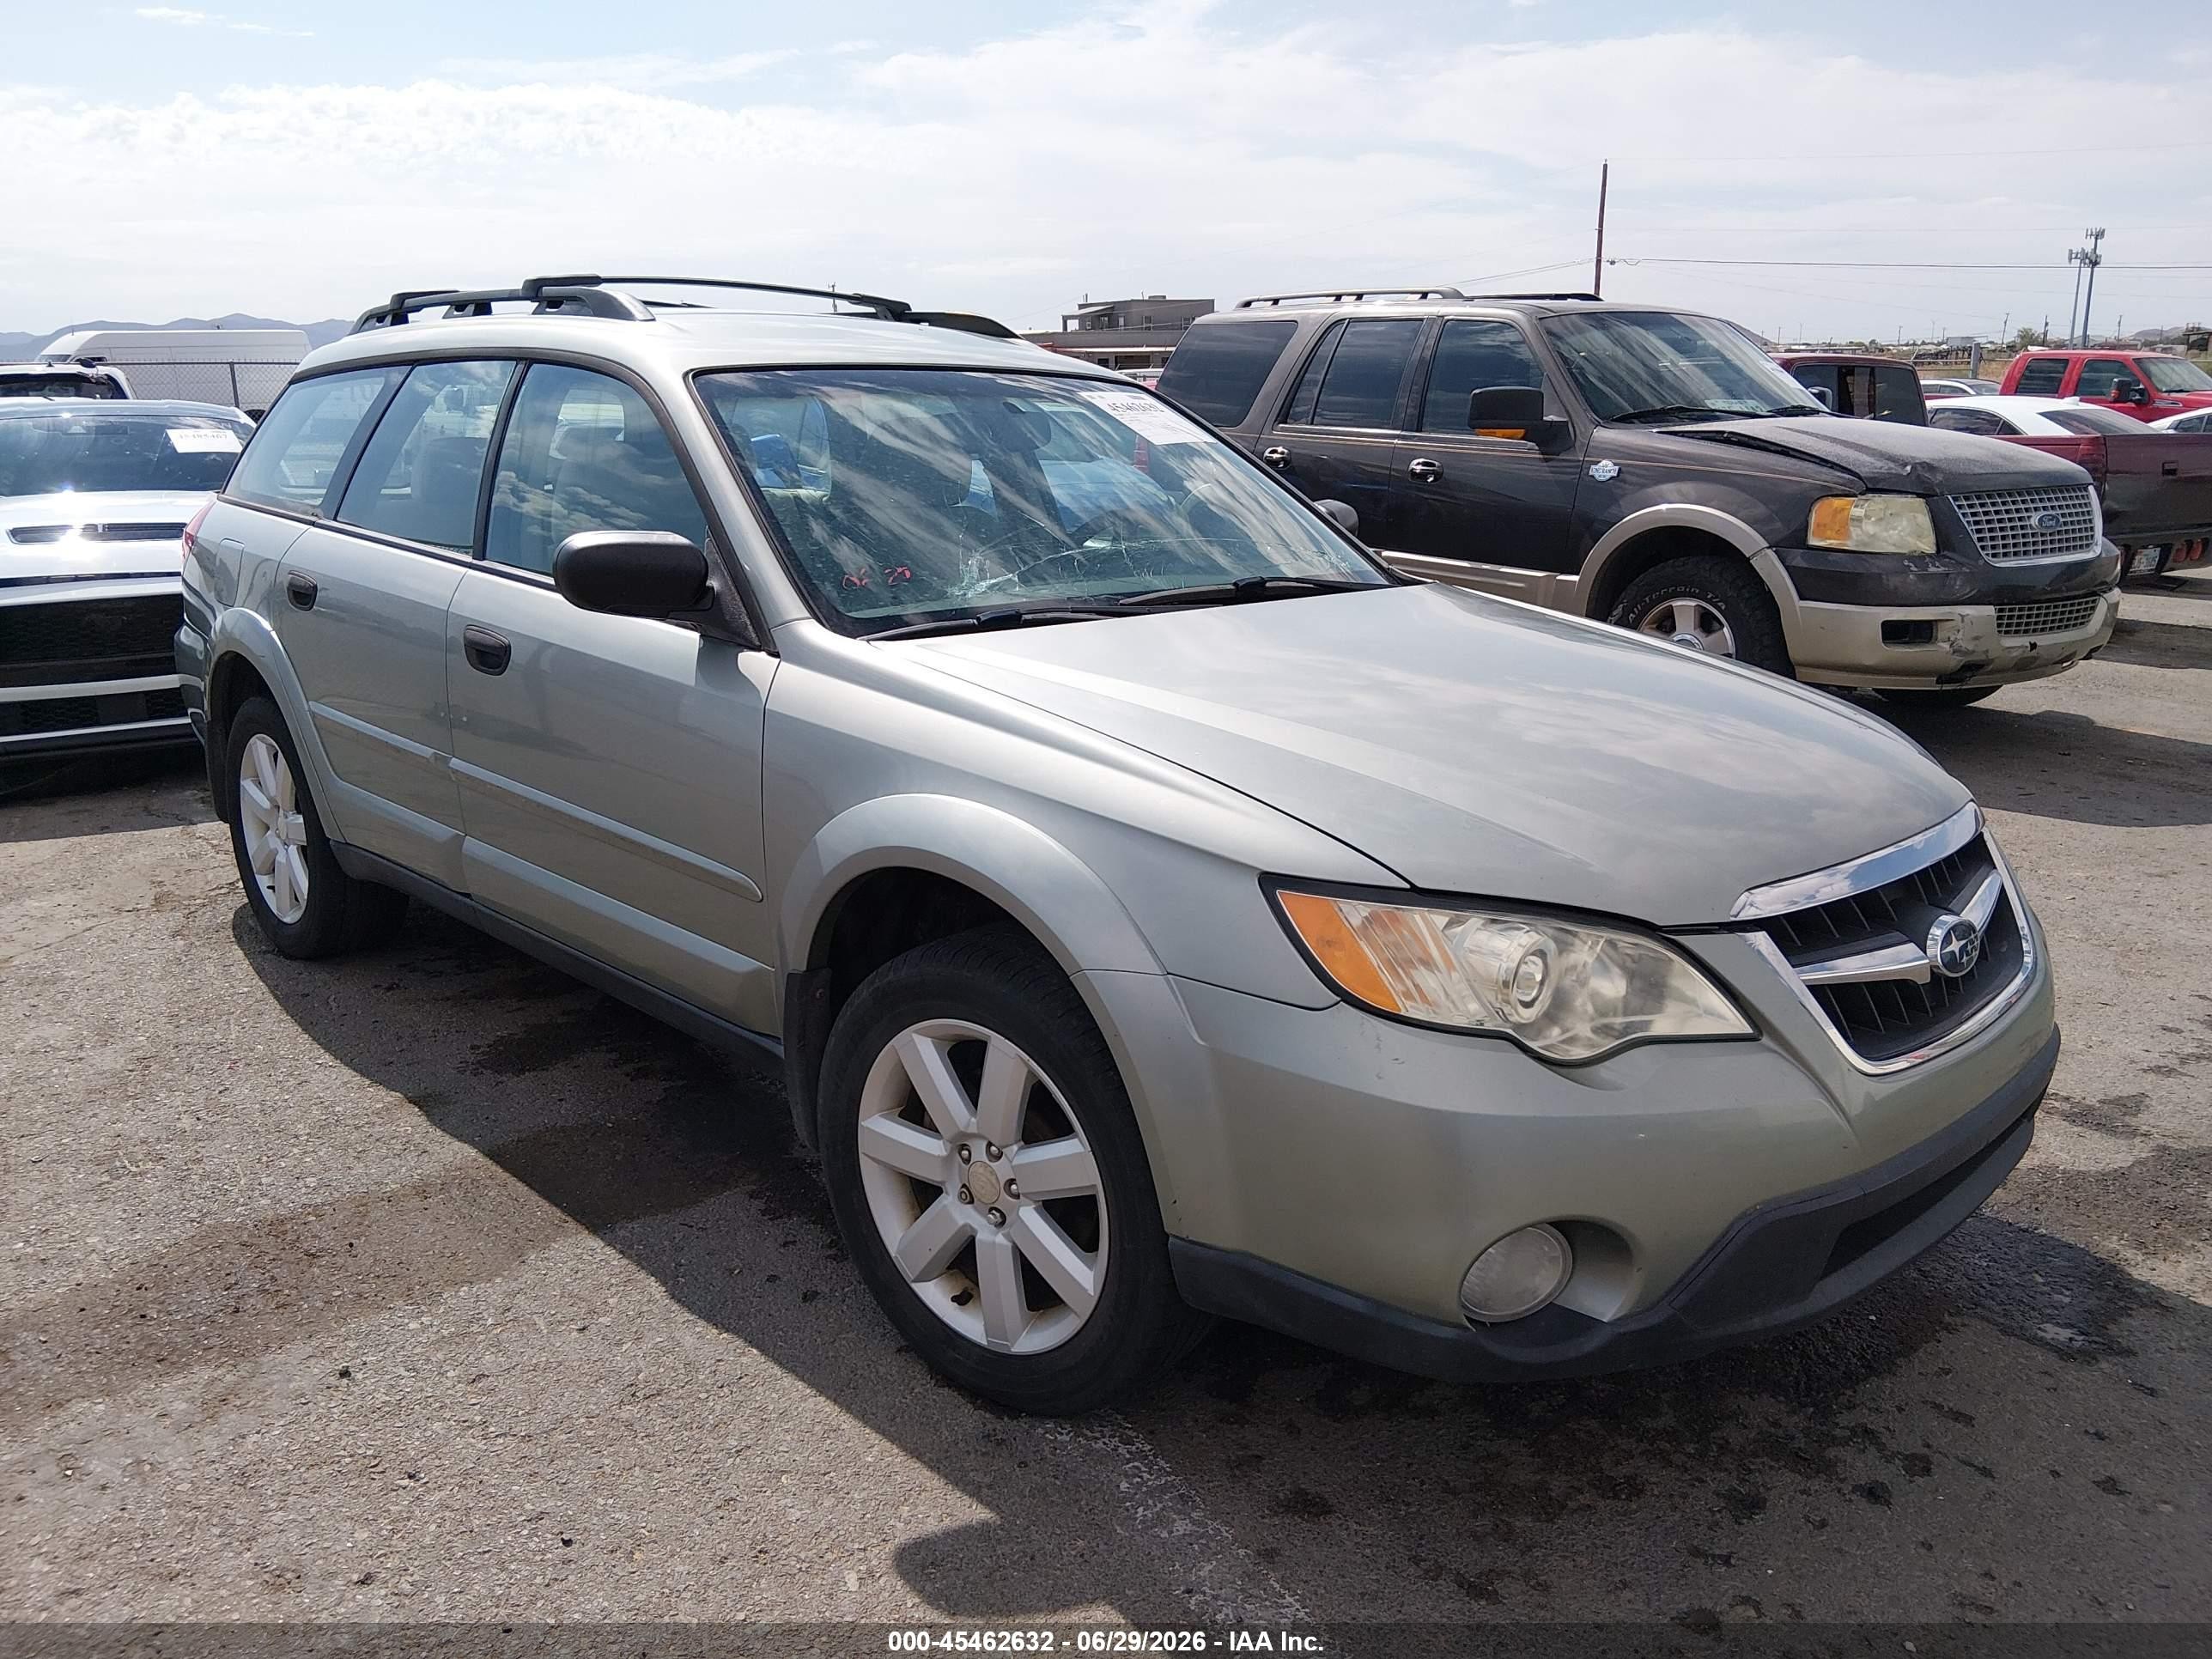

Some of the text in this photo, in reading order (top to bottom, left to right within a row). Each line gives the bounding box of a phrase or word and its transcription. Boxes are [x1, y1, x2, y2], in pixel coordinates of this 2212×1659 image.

[2042, 515, 2057, 526] Ford
[1628, 585, 1700, 623] All-Terrain
[1706, 591, 1726, 611] T/A
